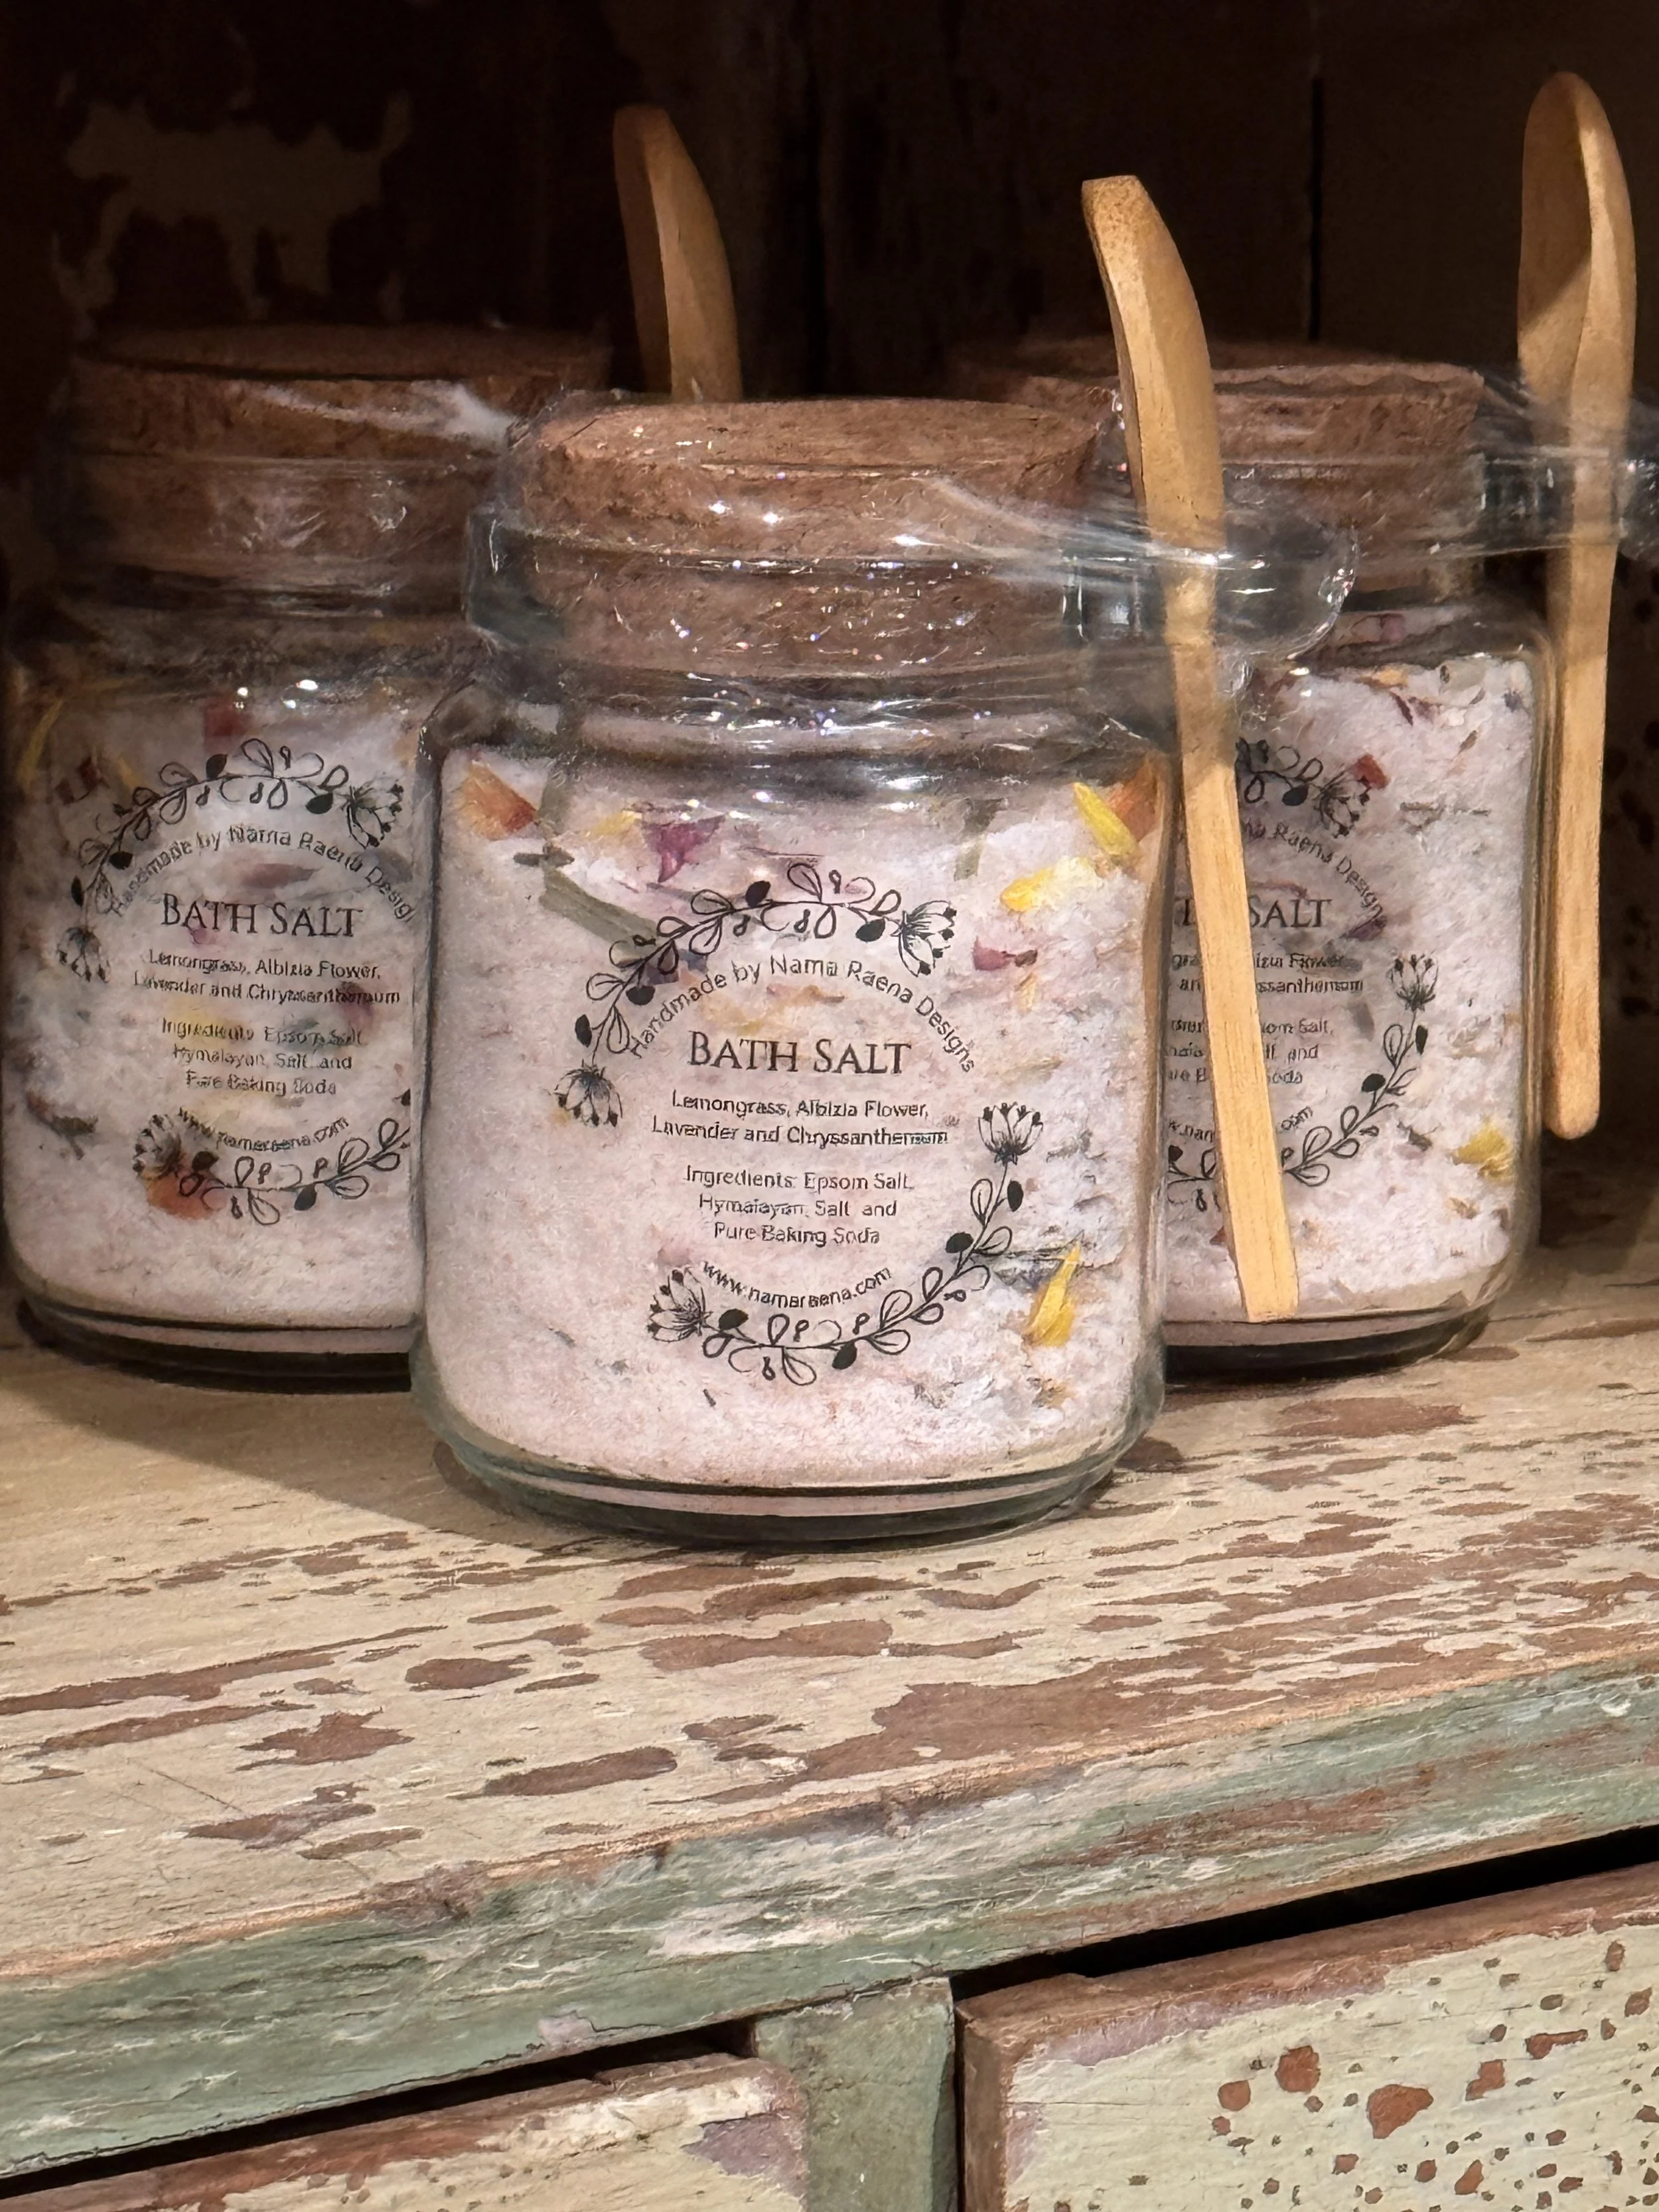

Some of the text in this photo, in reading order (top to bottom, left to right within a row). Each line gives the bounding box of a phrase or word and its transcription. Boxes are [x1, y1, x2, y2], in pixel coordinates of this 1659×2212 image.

[161, 892, 363, 937] BATH SALT
[630, 954, 975, 1073] Handmade by Nama Raena Designs
[687, 1030, 912, 1075] BATH SALT
[672, 1088, 929, 1121] Lemongrass, Albizia Flower,
[652, 1115, 740, 1141] Lavender
[743, 1125, 784, 1143] and
[804, 1171, 869, 1194] Epsom
[815, 1200, 849, 1217] Salt
[861, 1200, 897, 1217] and
[714, 1221, 881, 1248] Pure Baking Soda
[701, 1260, 893, 1309] www.namaraena.com
